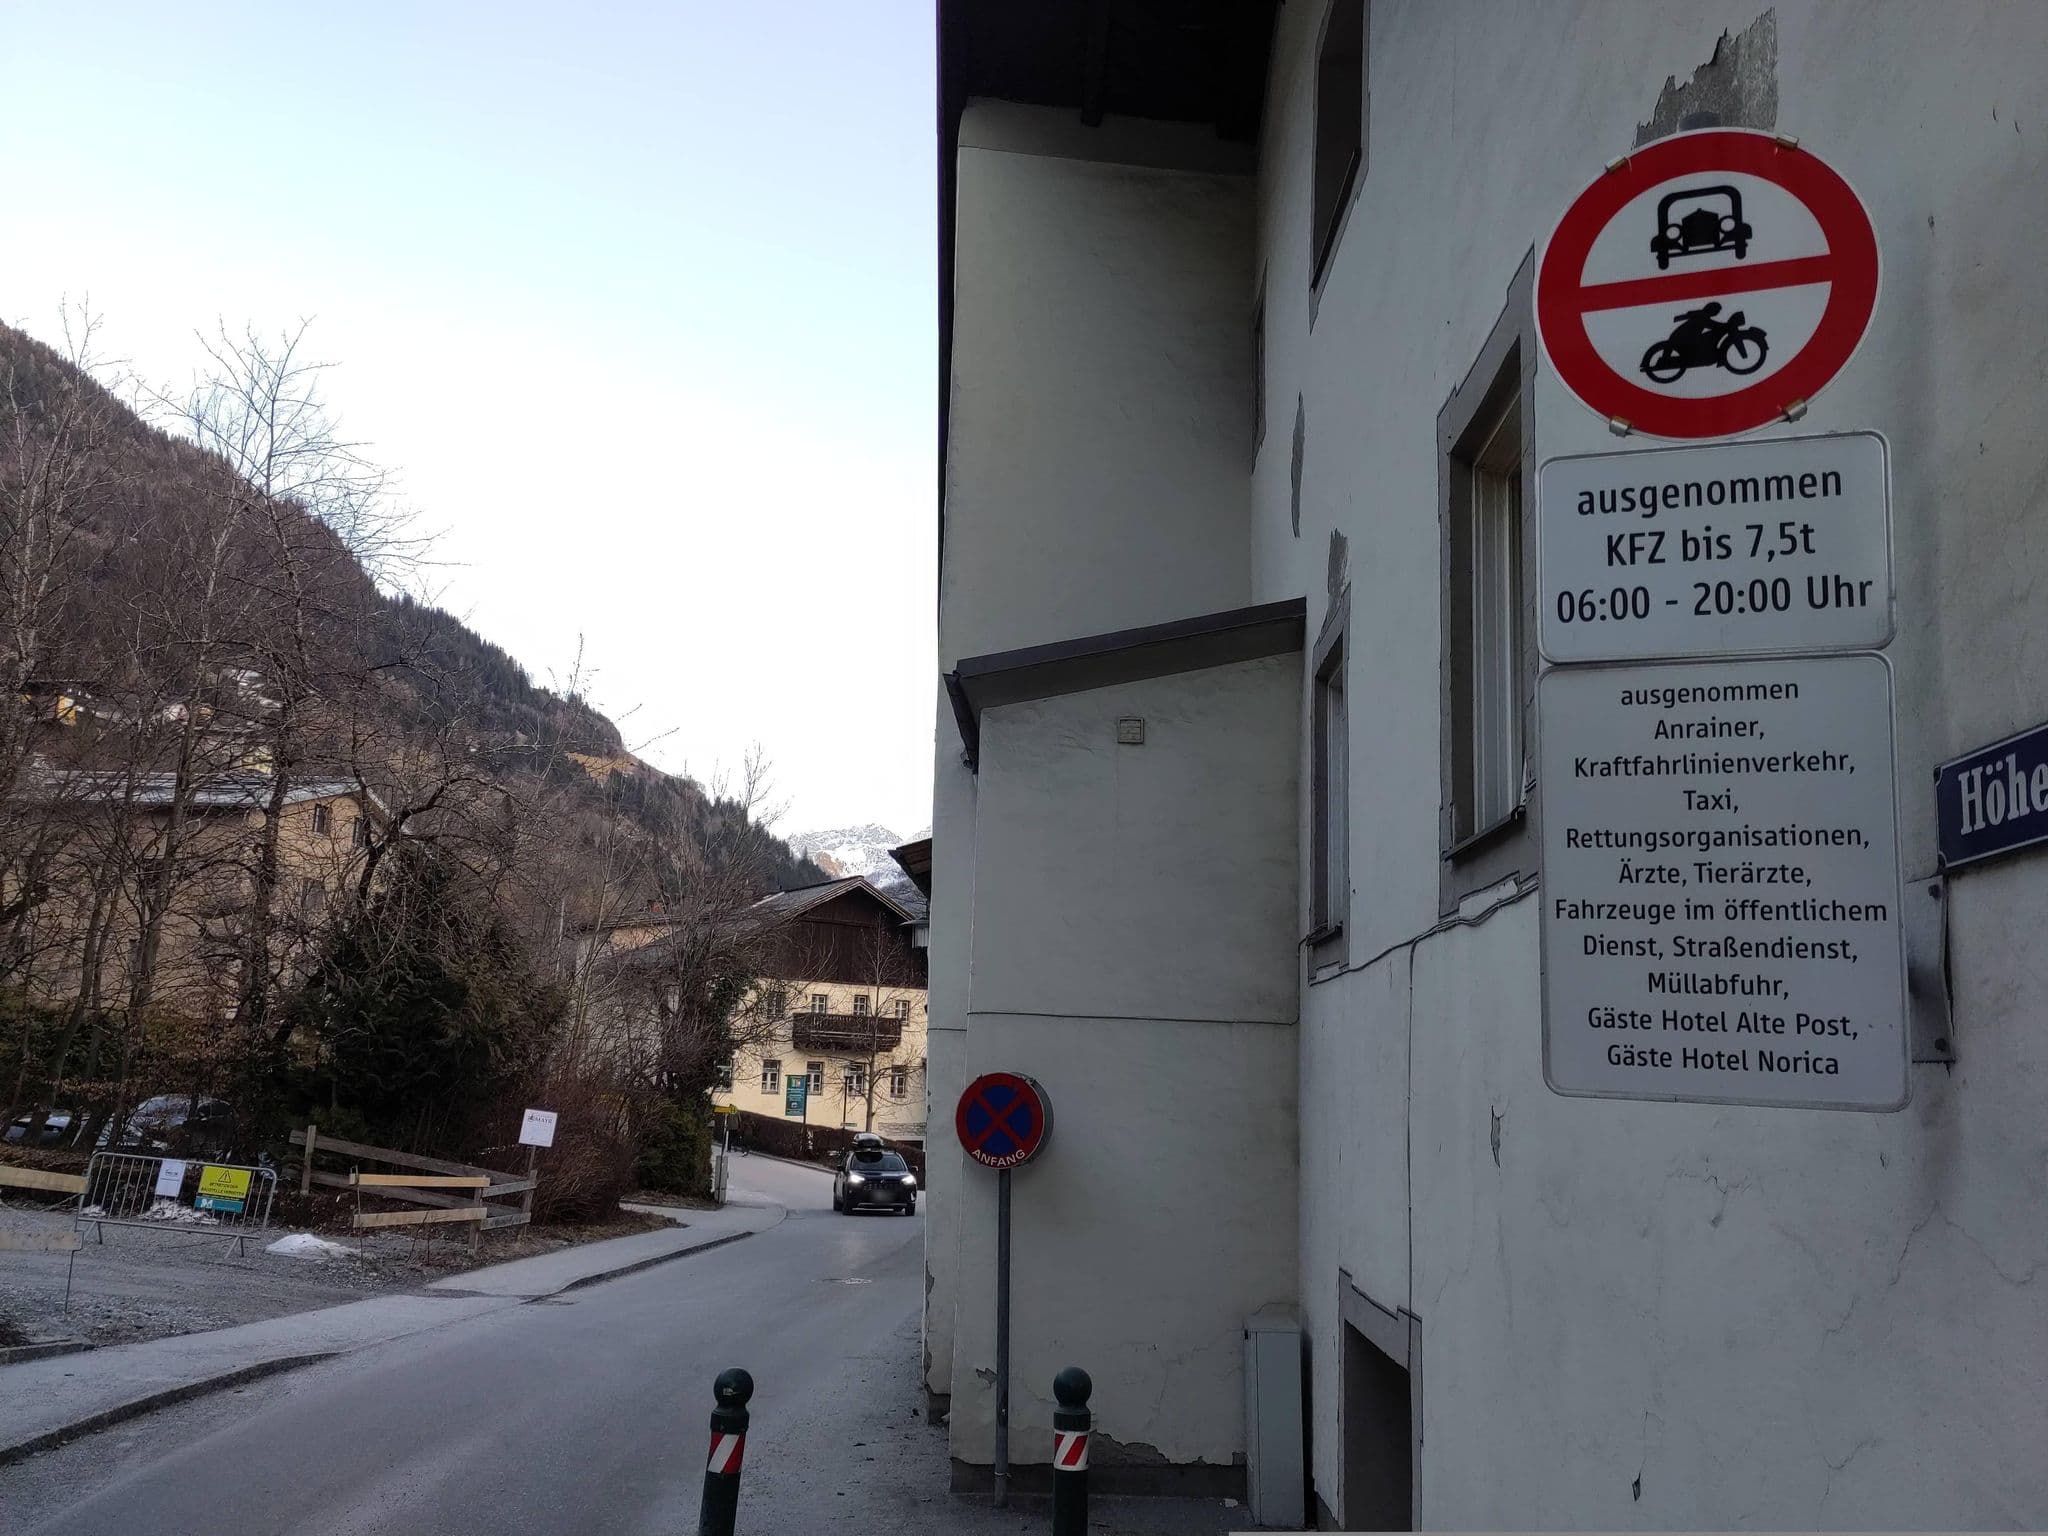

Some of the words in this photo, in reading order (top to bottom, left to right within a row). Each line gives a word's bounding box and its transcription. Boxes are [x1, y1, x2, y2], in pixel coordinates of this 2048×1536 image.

[1577, 470, 1842, 519] ausgenommen
[1606, 530, 1666, 567] KFZ
[1681, 525, 1733, 563] bis
[1745, 521, 1816, 563] 7,5t
[1556, 585, 1650, 624] 06:00
[1692, 577, 1791, 616] 20:00
[1806, 574, 1873, 610] Uhr
[1620, 682, 1799, 709] ausgenommen
[1653, 715, 1765, 741] Anrainer,
[1574, 749, 1855, 778] Kraftfahrlinienverkehr,
[1682, 787, 1739, 815] Taxi,
[1566, 824, 1870, 852] Rettungsorganisationen,
[1618, 857, 1688, 888] Ärzte,
[1692, 860, 1812, 888] Tierärzte,
[1555, 898, 1676, 926] Fahrzeuge
[1683, 897, 1715, 921] im
[1724, 897, 1887, 922] öffentlichem
[1583, 935, 1665, 961] Dienst,
[1672, 935, 1858, 964] Straßendienst,
[1648, 971, 1790, 1001] Müllabfuhr,
[1587, 1006, 1653, 1031] Gäste
[1662, 1009, 1729, 1033] Hotel
[1735, 1012, 1787, 1035] Alte
[1795, 1012, 1858, 1041] Post,
[1607, 1044, 1673, 1069] Gäste
[1682, 1047, 1749, 1072] Hotel
[1758, 1049, 1839, 1075] Norica
[971, 1148, 1026, 1167] ANFANG
